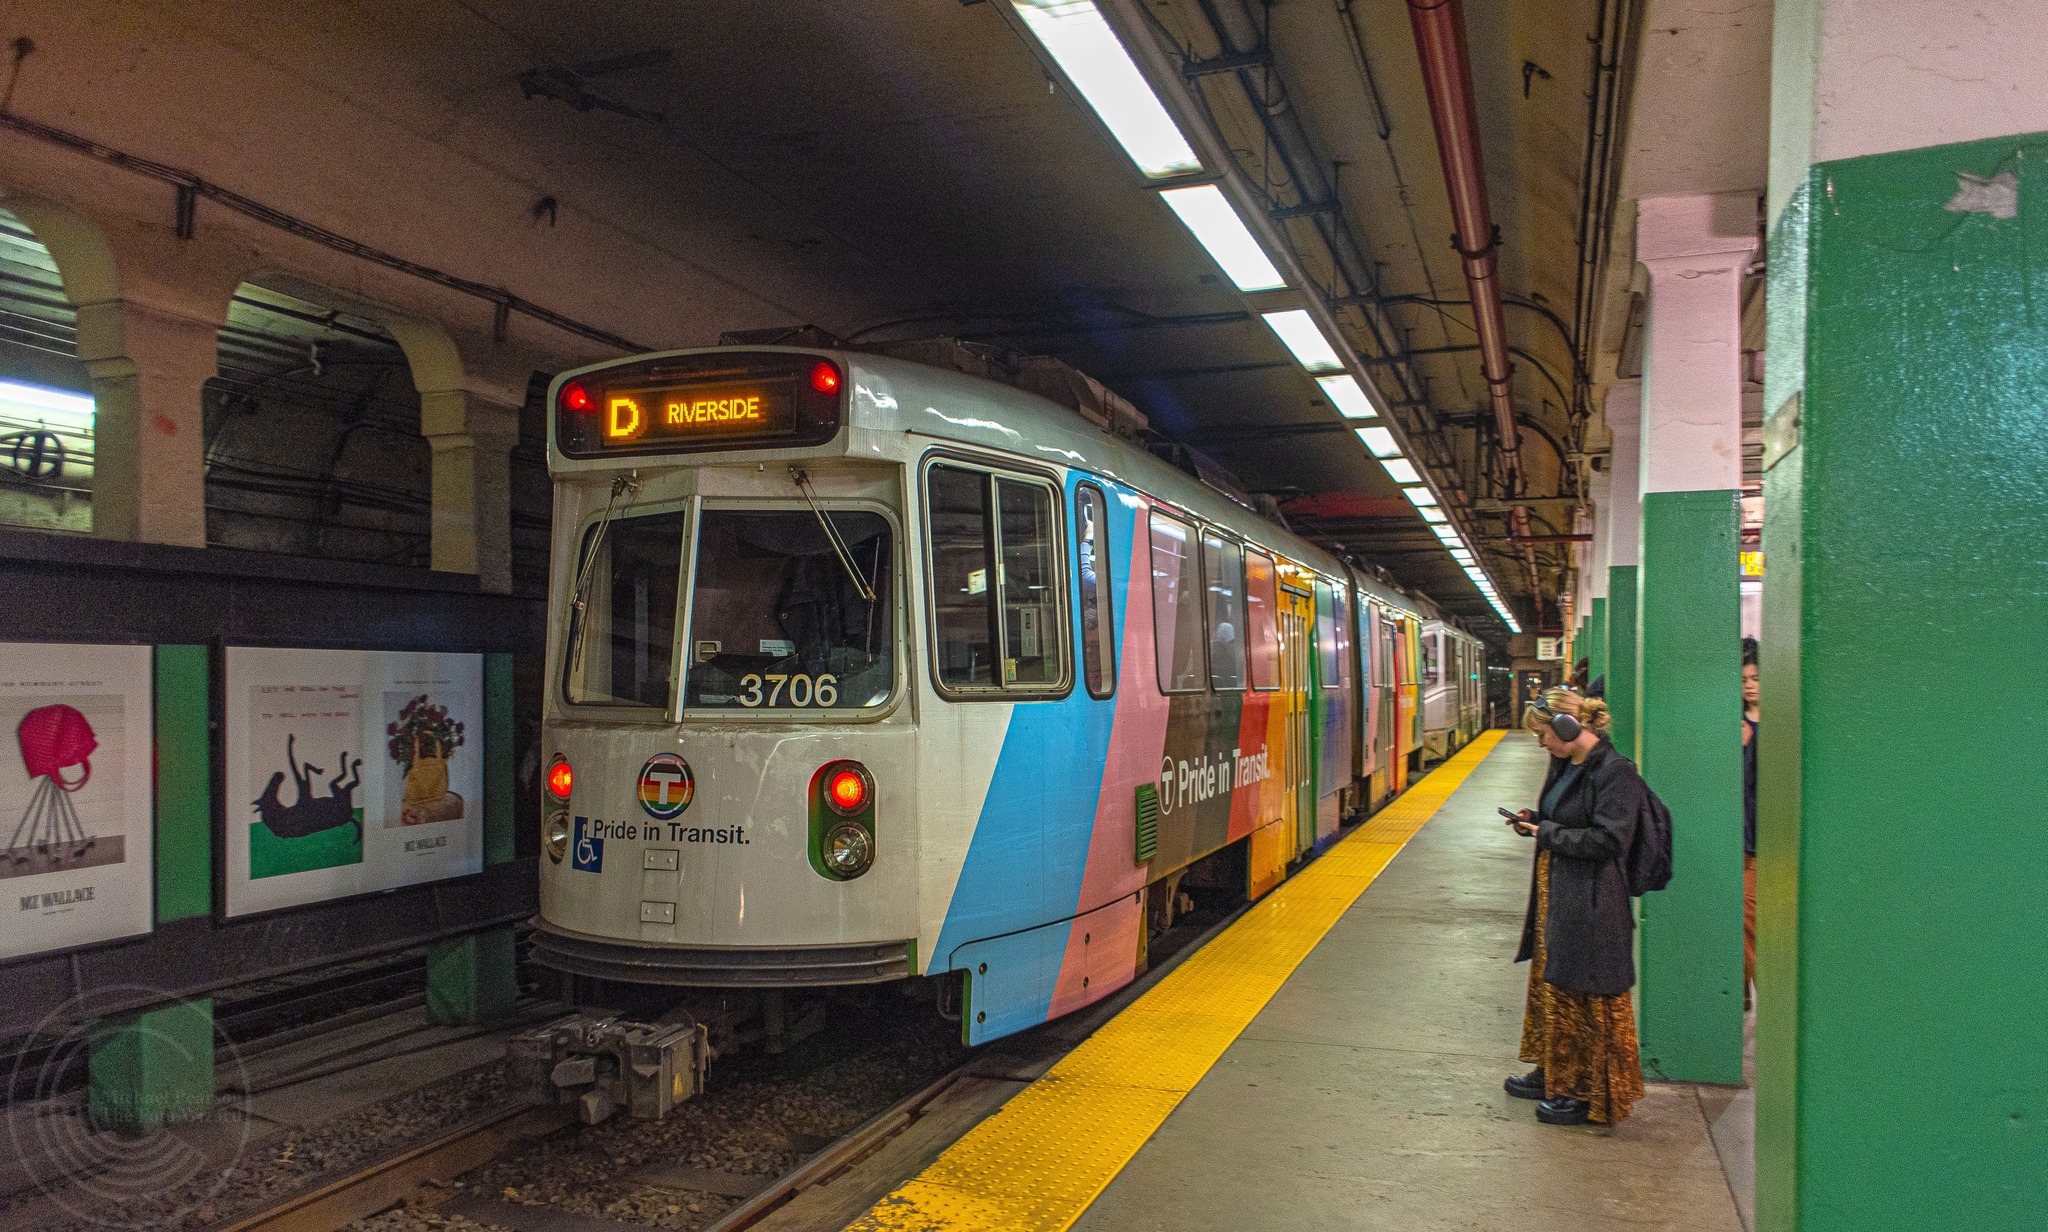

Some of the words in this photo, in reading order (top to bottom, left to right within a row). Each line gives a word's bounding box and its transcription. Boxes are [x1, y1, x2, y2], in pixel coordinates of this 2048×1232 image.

[611, 399, 639, 437] D
[668, 397, 760, 424] RIVERSIDE
[739, 673, 838, 707] 3706
[650, 772, 682, 805] T
[1162, 770, 1173, 805] T
[1178, 755, 1216, 808] Pride
[1218, 752, 1230, 795] in
[1232, 743, 1271, 789] Transit.
[594, 819, 637, 840] Pride
[643, 822, 660, 841] in
[667, 822, 750, 845] Transit.
[41, 886, 96, 908] WALLACE
